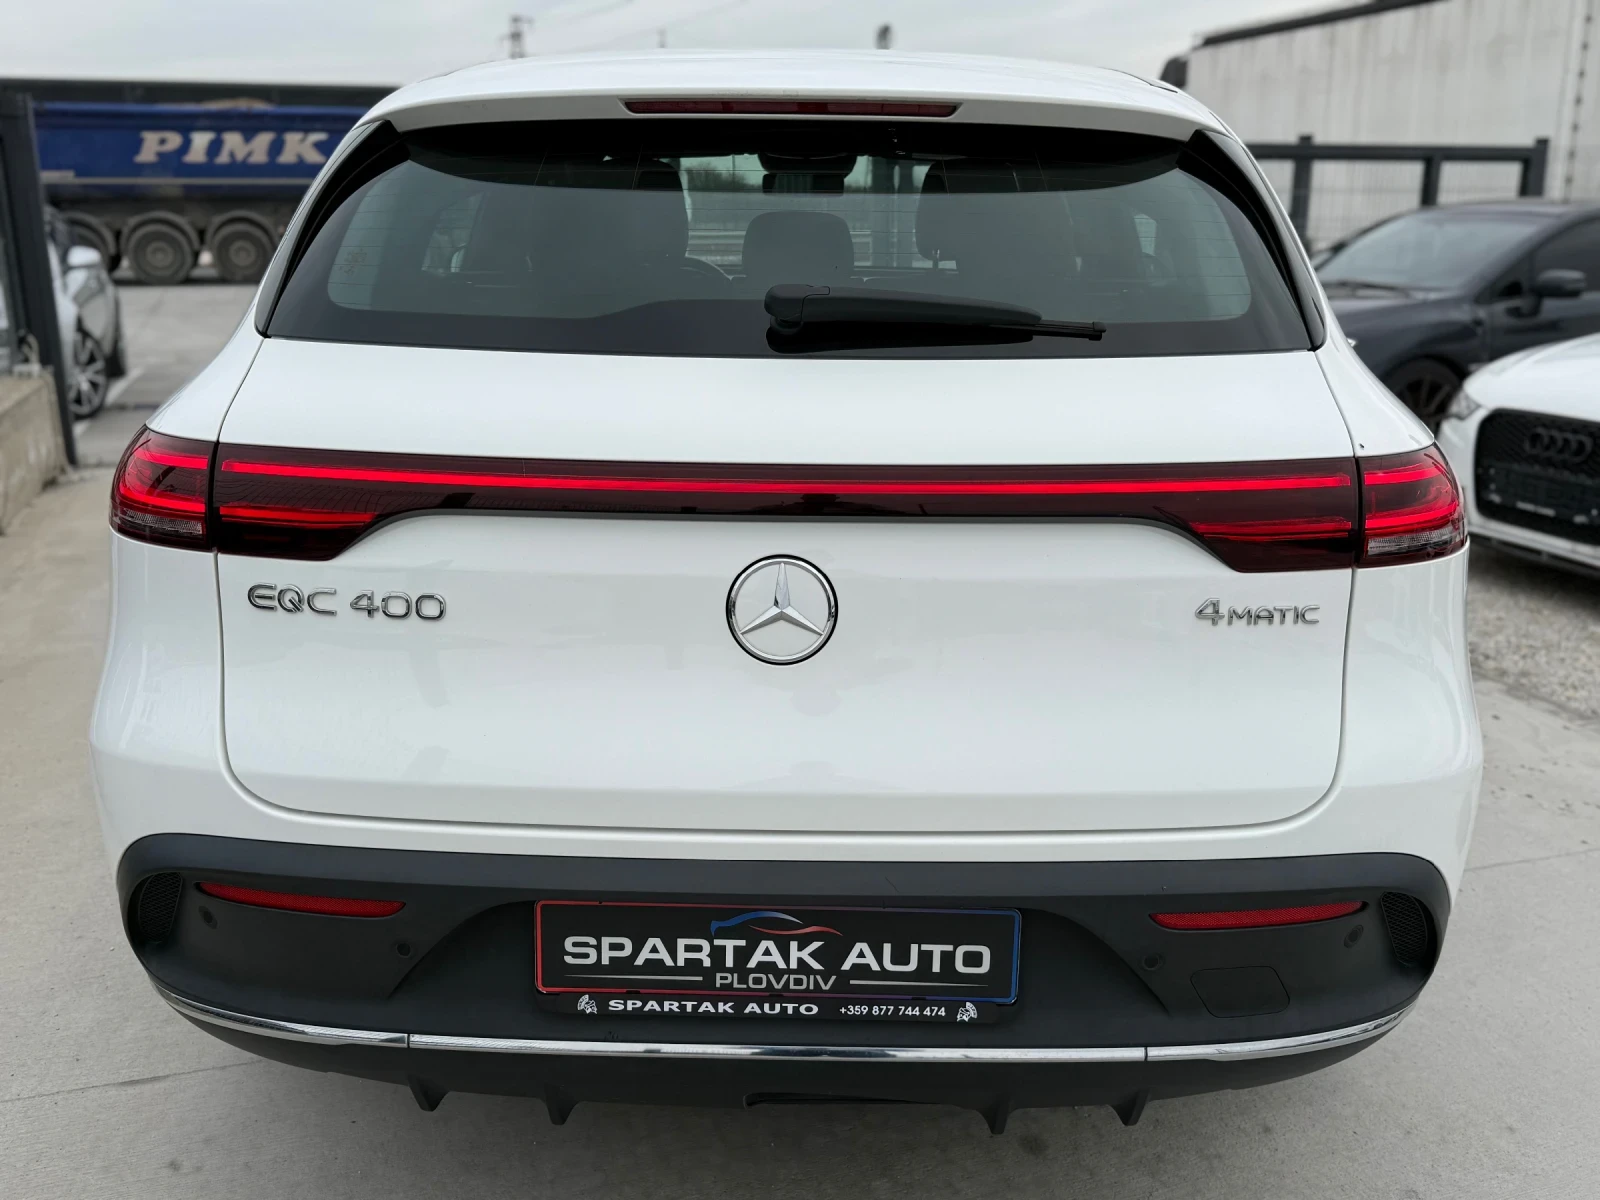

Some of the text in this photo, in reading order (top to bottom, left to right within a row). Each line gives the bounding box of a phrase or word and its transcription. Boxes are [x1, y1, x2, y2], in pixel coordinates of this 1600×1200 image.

[133, 130, 328, 164] PIMK
[247, 583, 447, 620] EQC 400
[1194, 597, 1321, 627] 4MATIC
[563, 935, 991, 974] SPARTAK AUTO
[715, 972, 837, 991] PLOVDIV
[607, 999, 946, 1017] SPARTAK AUTO +359 877 744 474
